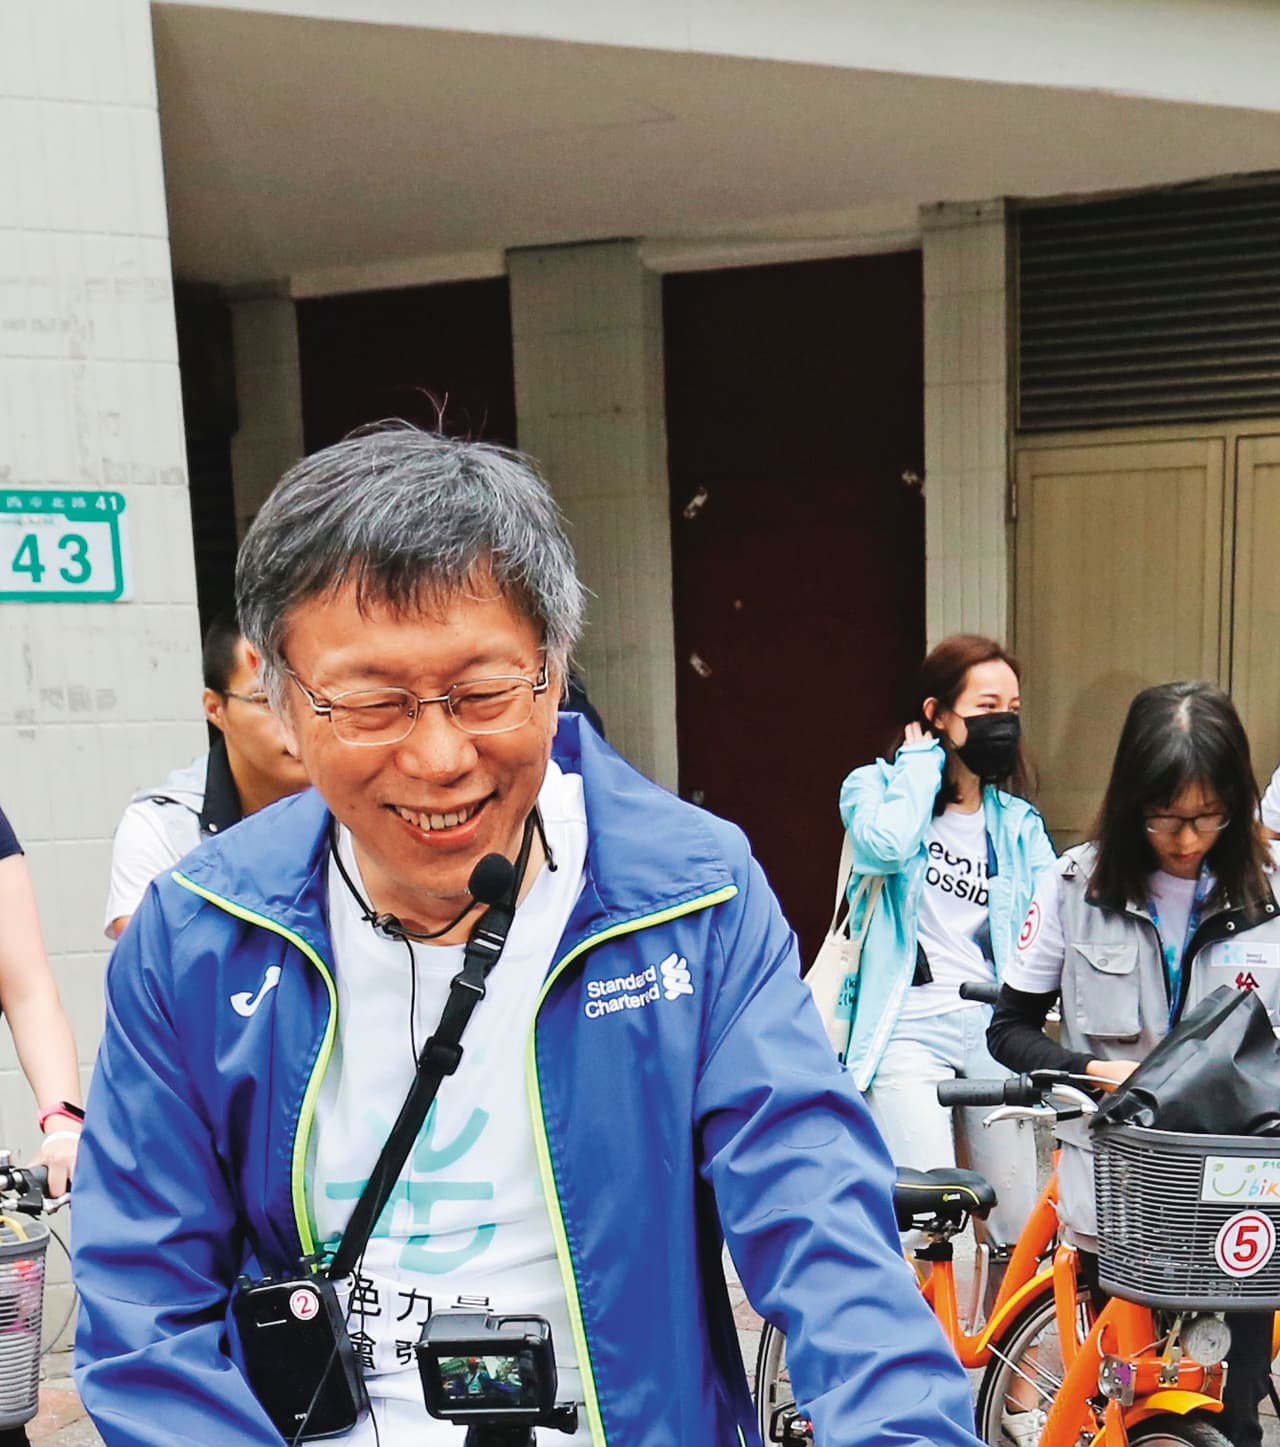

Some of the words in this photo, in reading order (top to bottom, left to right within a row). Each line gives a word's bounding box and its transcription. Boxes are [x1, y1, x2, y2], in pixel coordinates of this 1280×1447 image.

[95, 495, 119, 511] 41
[11, 533, 92, 584] 43
[1234, 1226, 1260, 1262] 5
[296, 1294, 312, 1315] 2
